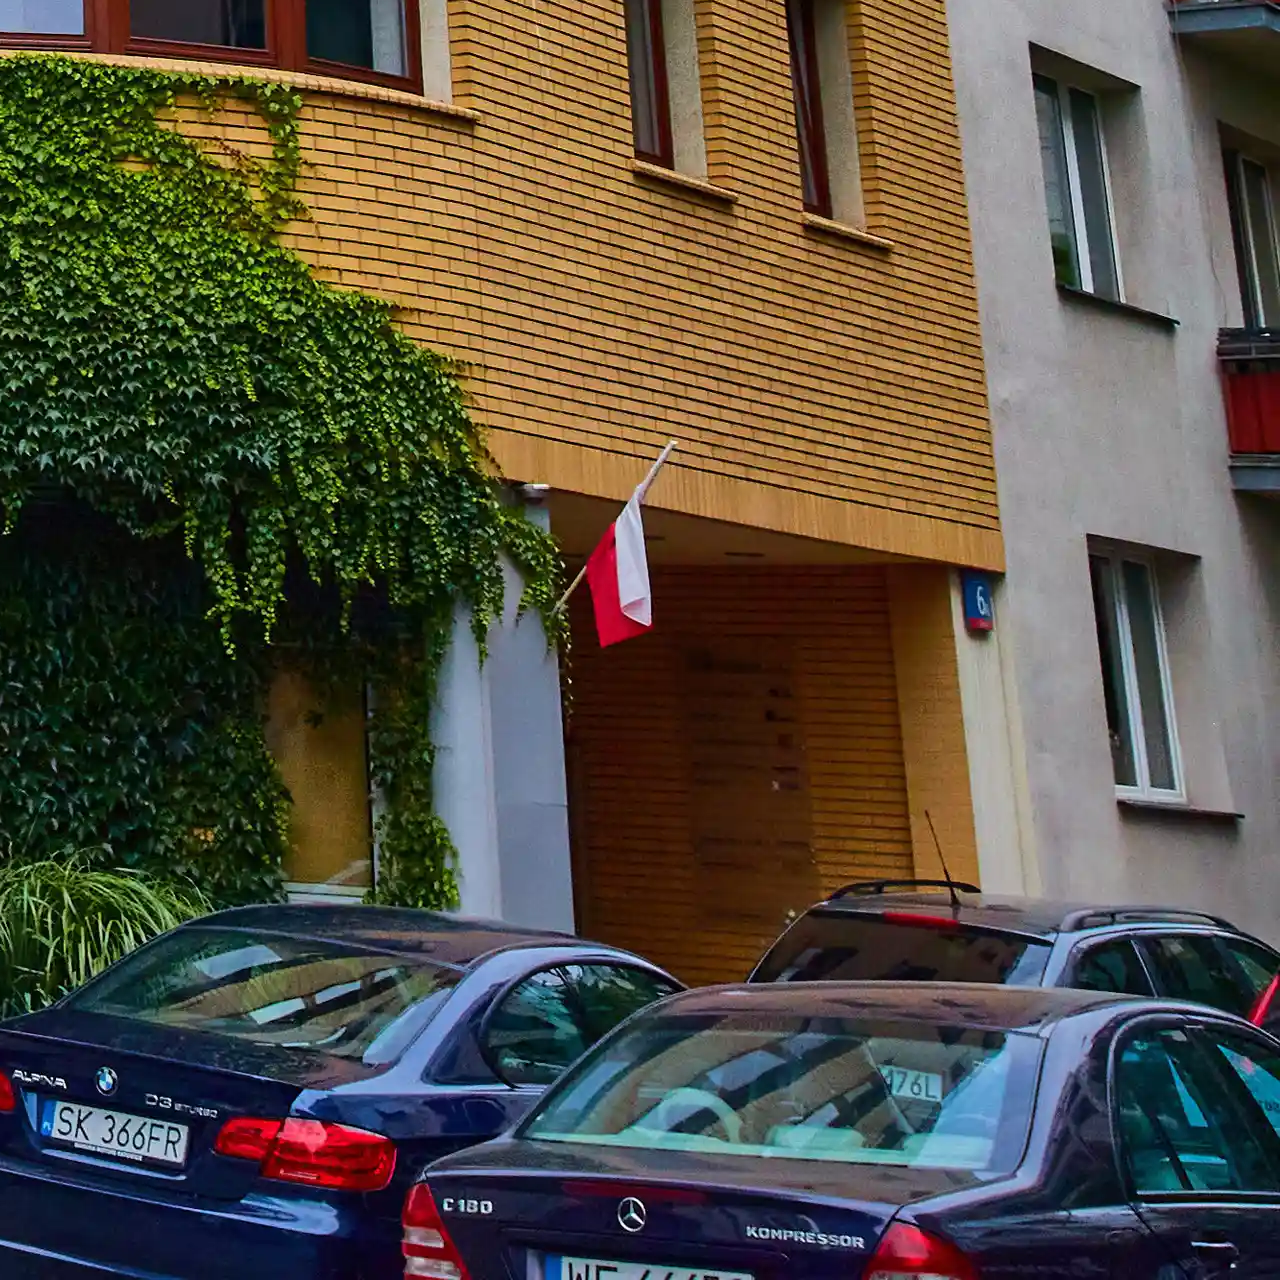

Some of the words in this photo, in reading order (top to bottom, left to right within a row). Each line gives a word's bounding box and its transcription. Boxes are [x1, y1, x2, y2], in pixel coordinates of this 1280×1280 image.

[144, 1093, 173, 1109] D3
[57, 1106, 93, 1141] SK
[101, 1114, 182, 1158] 366FR
[443, 1198, 454, 1212] C
[459, 1199, 493, 1214] 180
[746, 1226, 865, 1249] KOMPRESSOR
